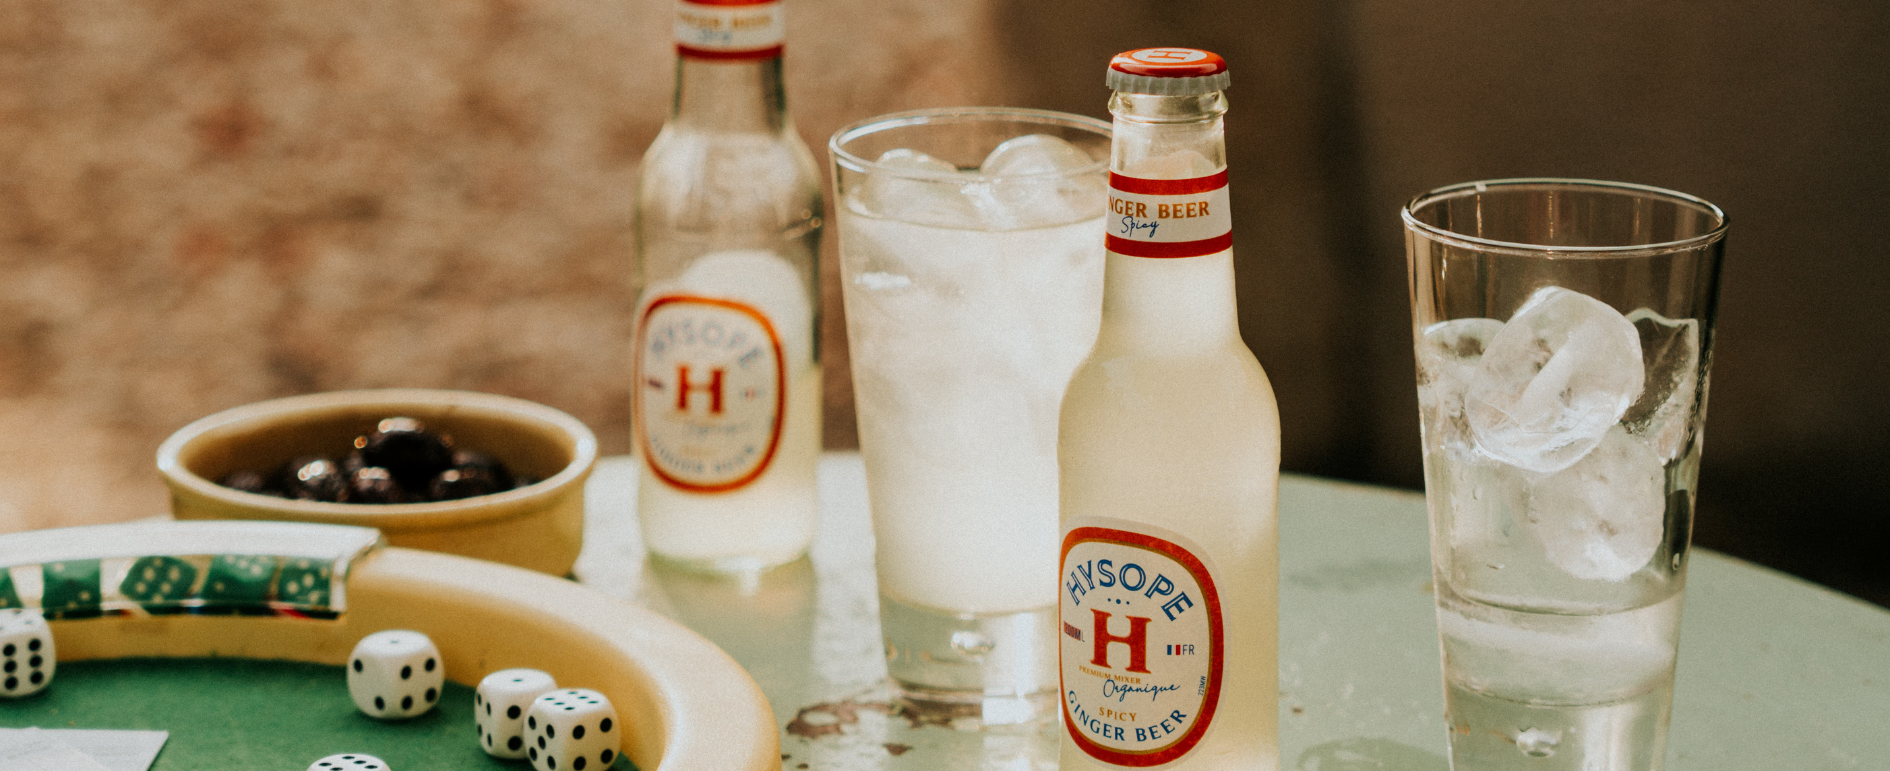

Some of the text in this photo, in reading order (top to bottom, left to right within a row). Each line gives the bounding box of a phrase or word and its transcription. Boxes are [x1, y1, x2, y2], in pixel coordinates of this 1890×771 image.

[1157, 201, 1210, 219] BEER
[1121, 215, 1160, 238] Spicy
[677, 362, 726, 415] H
[1066, 559, 1194, 622] HYSOPE
[1090, 607, 1153, 674] H
[1182, 644, 1195, 656] FR
[1079, 664, 1142, 685] PREMIUM MIXER
[1103, 679, 1181, 702] Organique
[1068, 690, 1187, 743] GINGER BEER
[1098, 706, 1138, 722] SPICY
